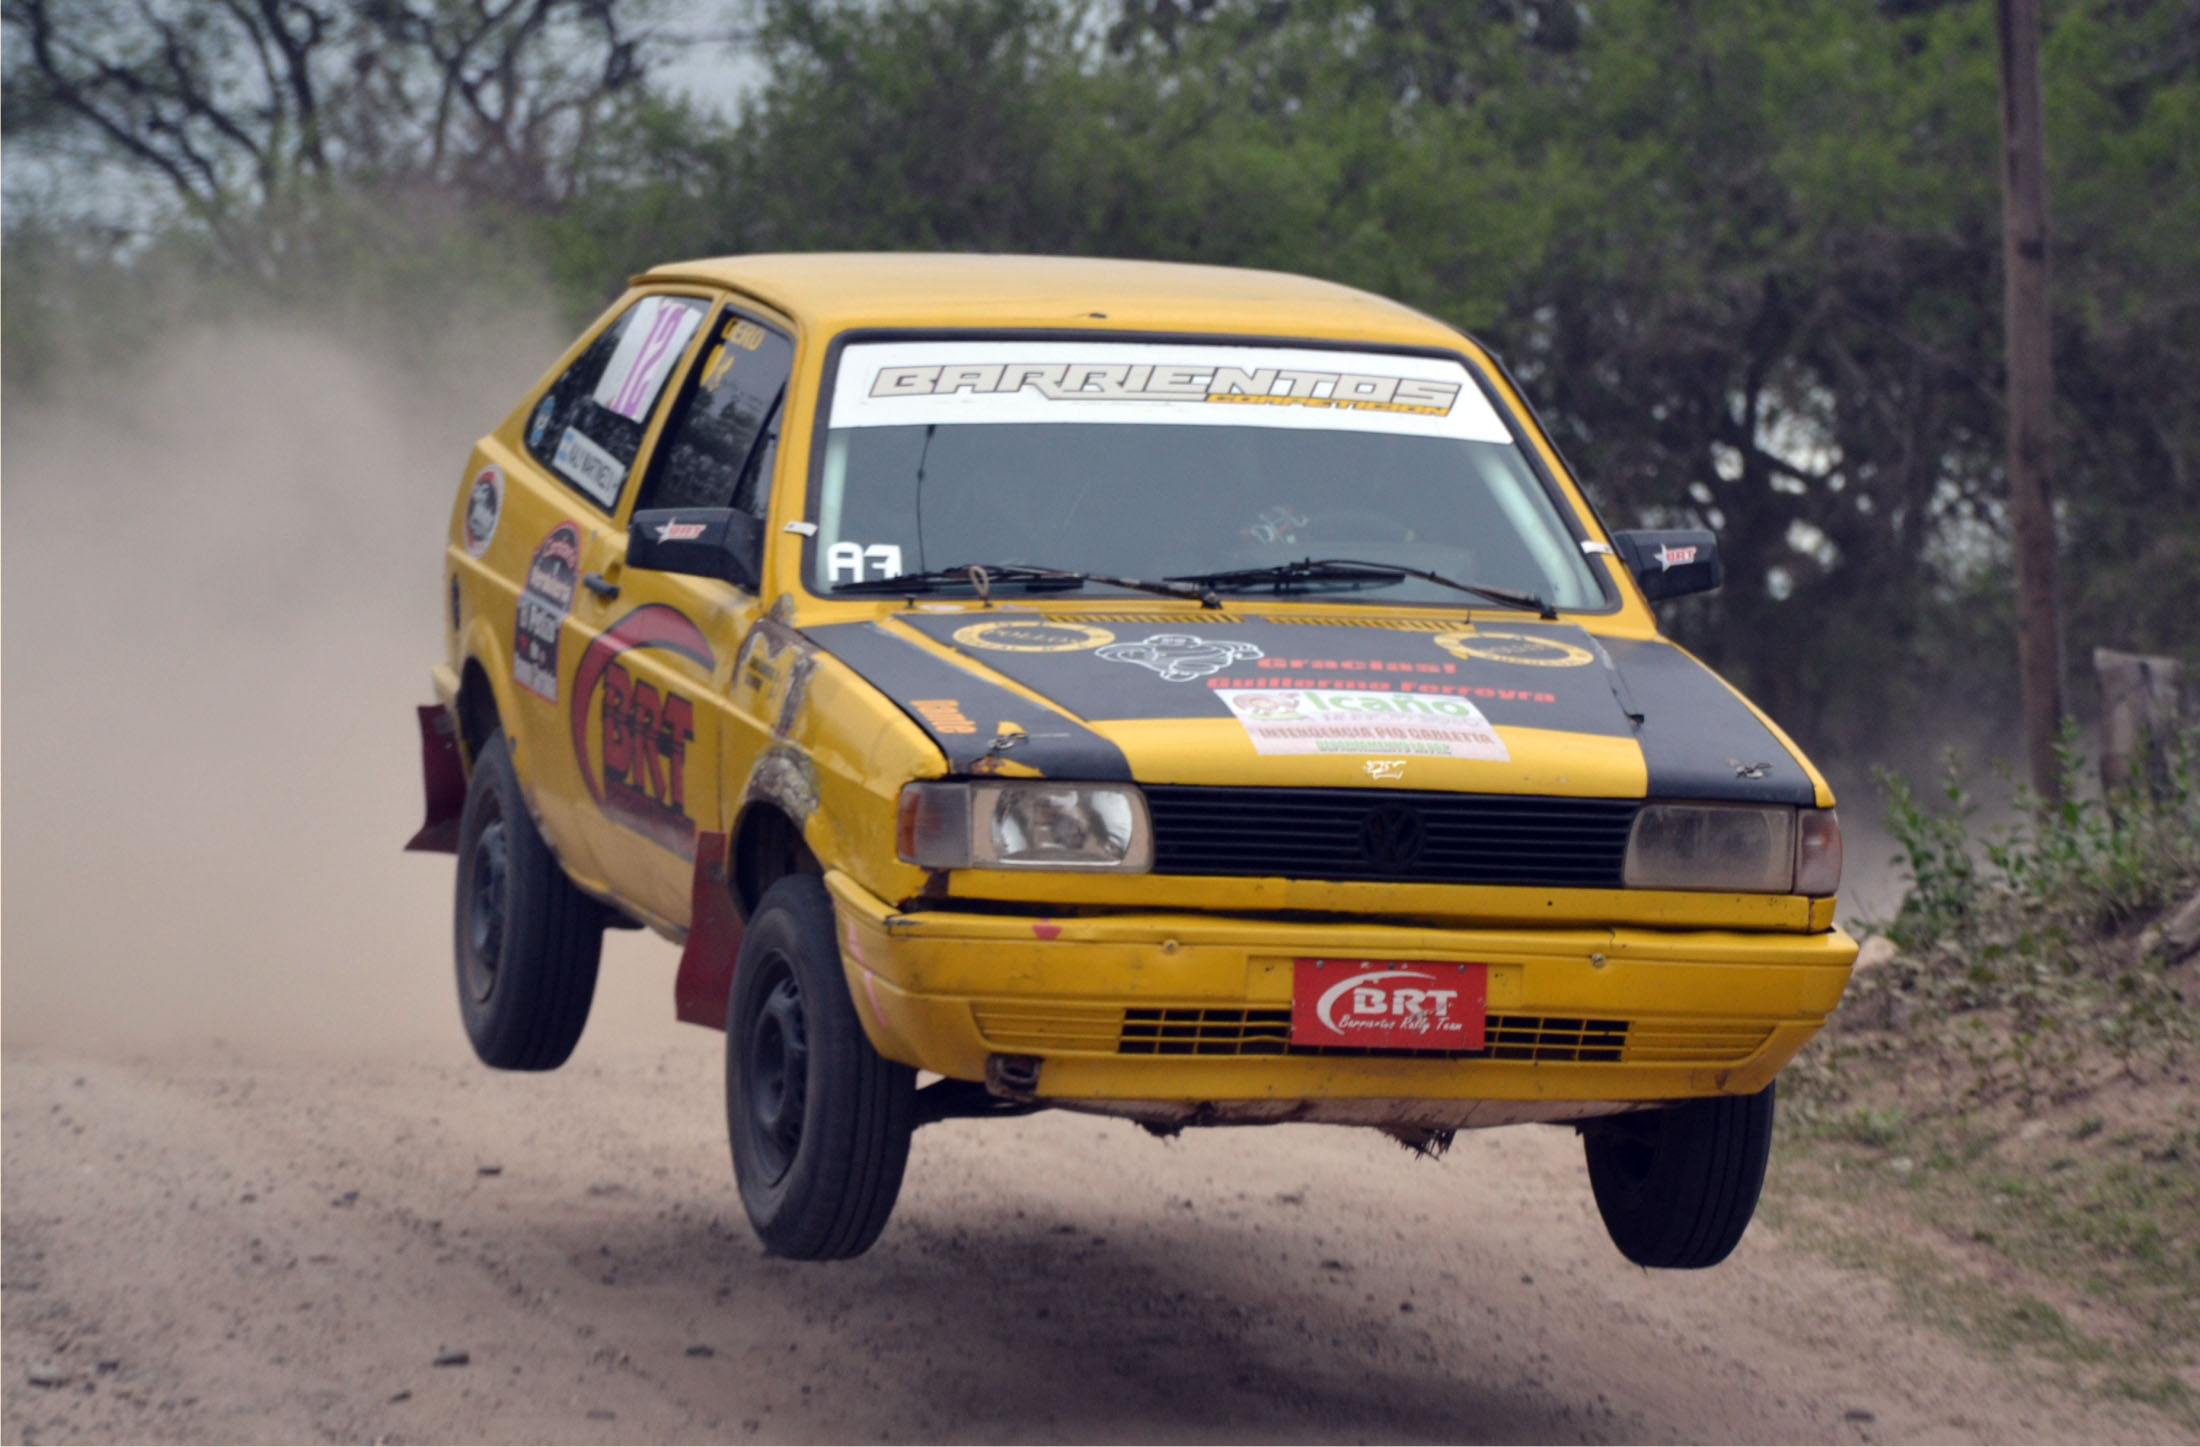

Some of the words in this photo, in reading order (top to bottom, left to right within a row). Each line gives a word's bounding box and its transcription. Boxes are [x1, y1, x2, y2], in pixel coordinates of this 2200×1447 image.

[869, 364, 1463, 409] BARRIENTOS
[603, 661, 695, 815] BRT
[1353, 987, 1458, 1016] BRT
[1436, 1015, 1463, 1031] Team
